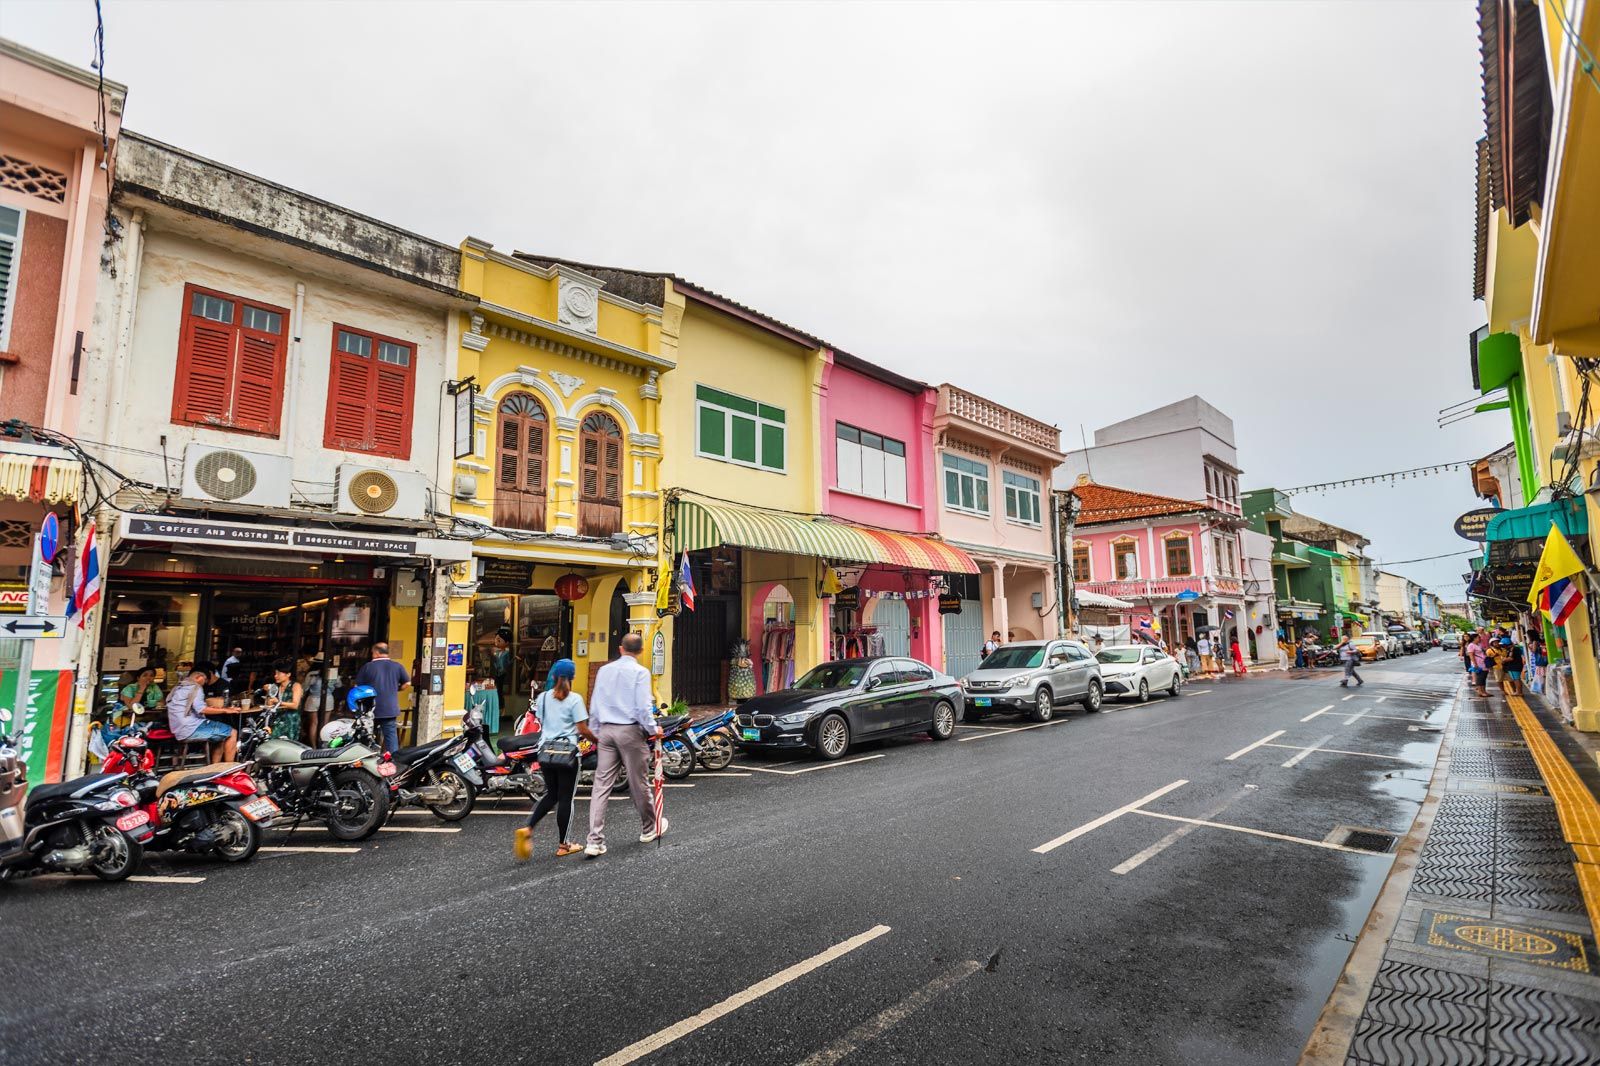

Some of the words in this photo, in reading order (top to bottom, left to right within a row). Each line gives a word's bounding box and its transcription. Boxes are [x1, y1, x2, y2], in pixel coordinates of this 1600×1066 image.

[1460, 522, 1486, 530] Hostel
[159, 525, 199, 534] COFFEE
[232, 530, 268, 539] GASTRO
[305, 537, 352, 546] BOOKSTORE
